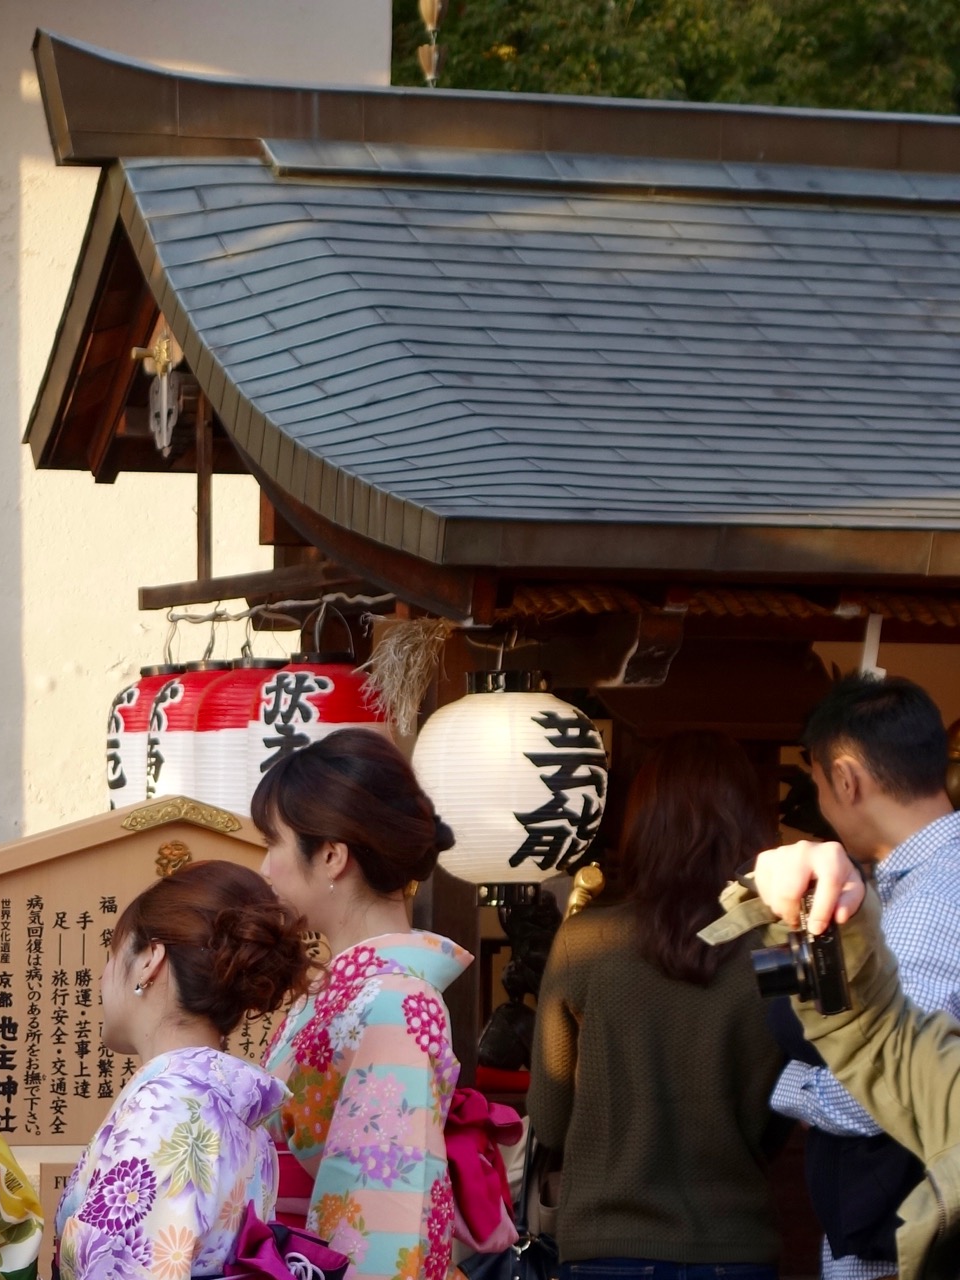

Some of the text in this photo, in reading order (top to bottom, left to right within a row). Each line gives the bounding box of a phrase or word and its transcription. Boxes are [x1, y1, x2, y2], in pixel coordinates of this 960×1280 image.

[509, 708, 608, 872] 芸能
[0, 898, 11, 964] 世界文化遺産
